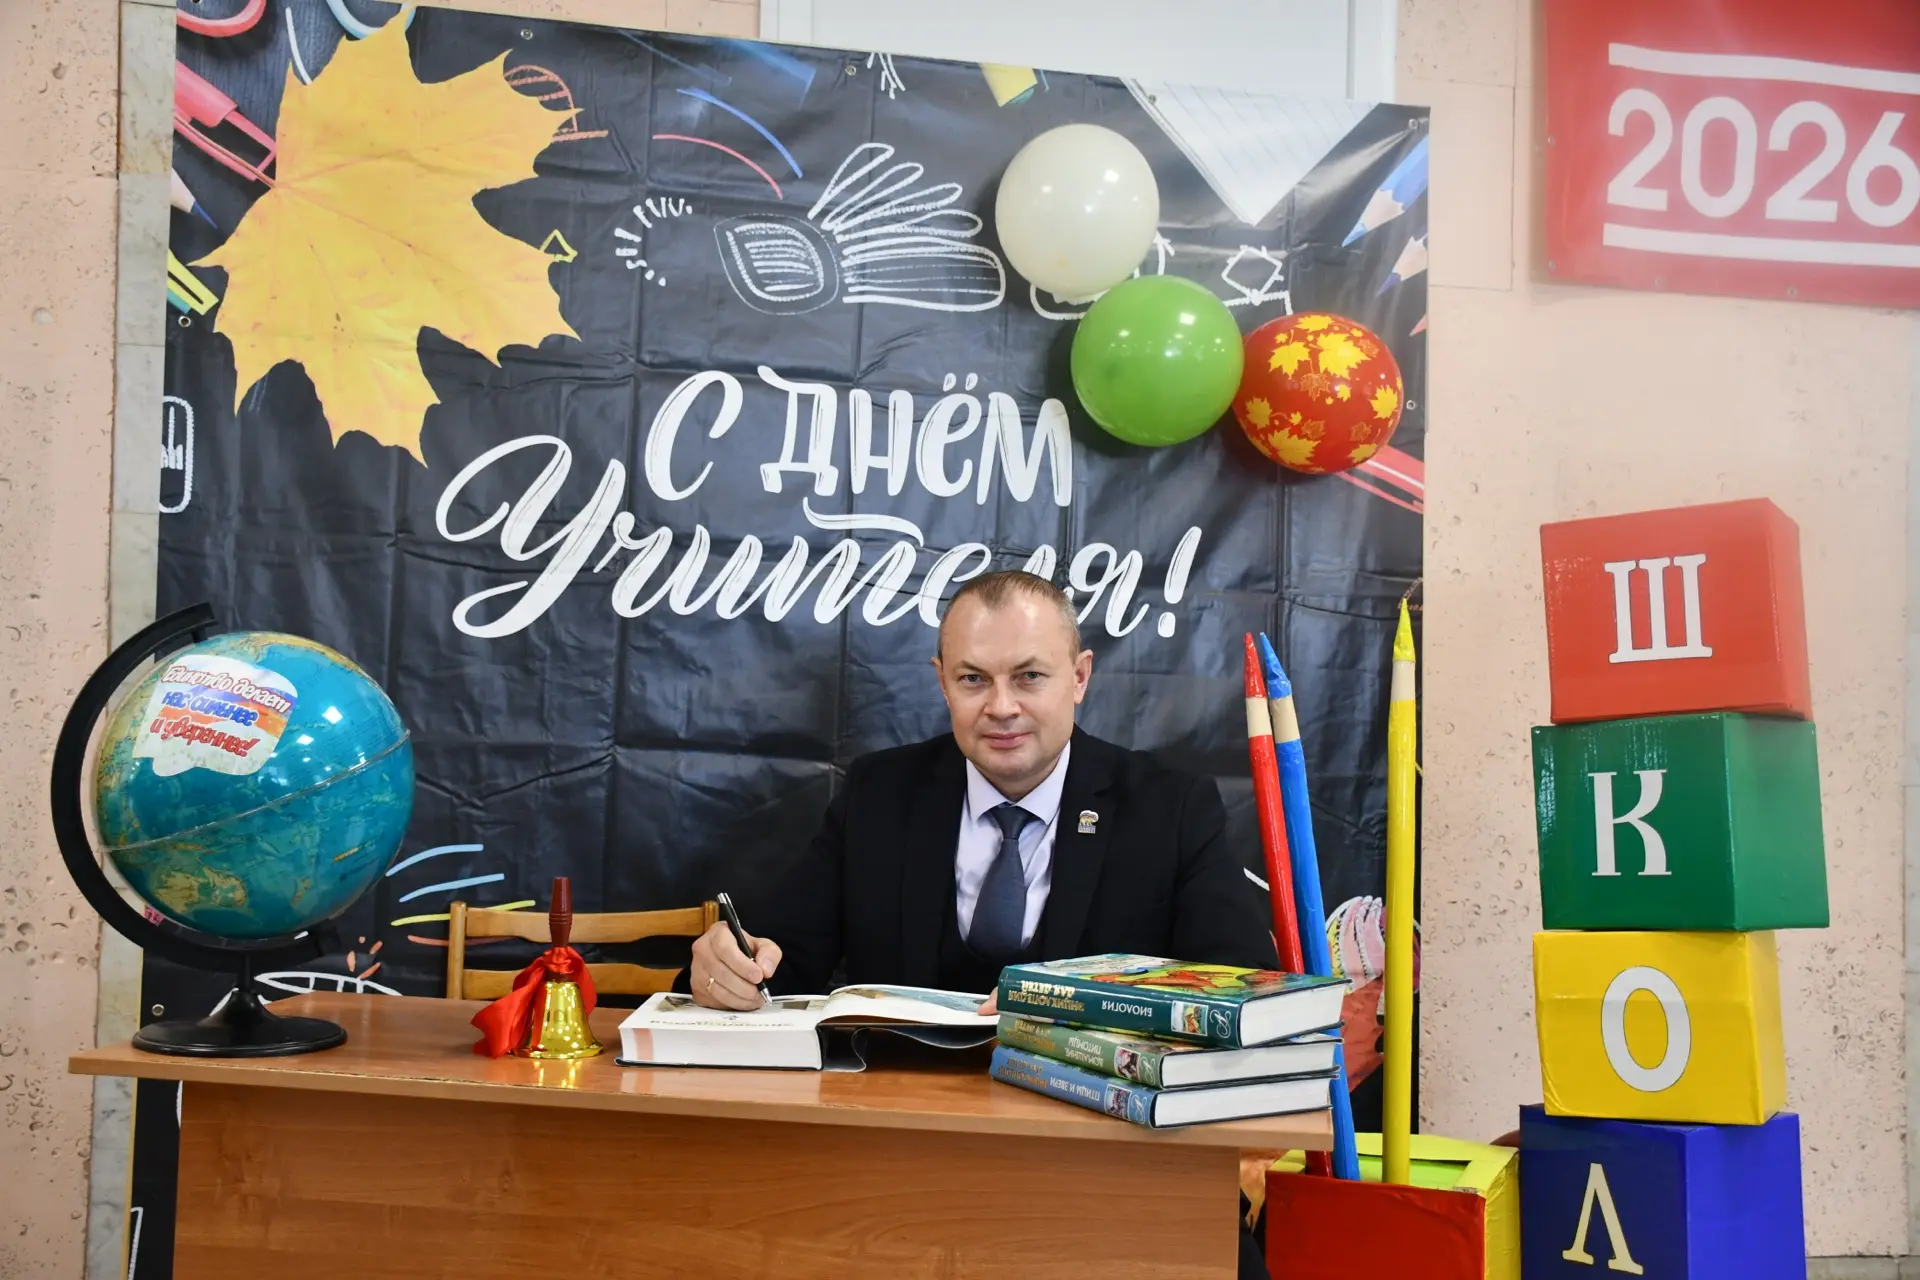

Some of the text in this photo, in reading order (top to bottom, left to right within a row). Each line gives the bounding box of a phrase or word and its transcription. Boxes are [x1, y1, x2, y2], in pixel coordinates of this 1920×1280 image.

[1606, 87, 1920, 228] 2026
[645, 369, 744, 502] С
[161, 665, 292, 714] Единство делает
[161, 690, 259, 727] нас сильнее
[150, 716, 261, 757] и увереннее!
[1007, 990, 1085, 1012] ЭНЦИКЛОПЕДИЯ
[1101, 1000, 1153, 1017] БИОЛОГИЯ
[1076, 1084, 1101, 1102] ПТИЦЫ
